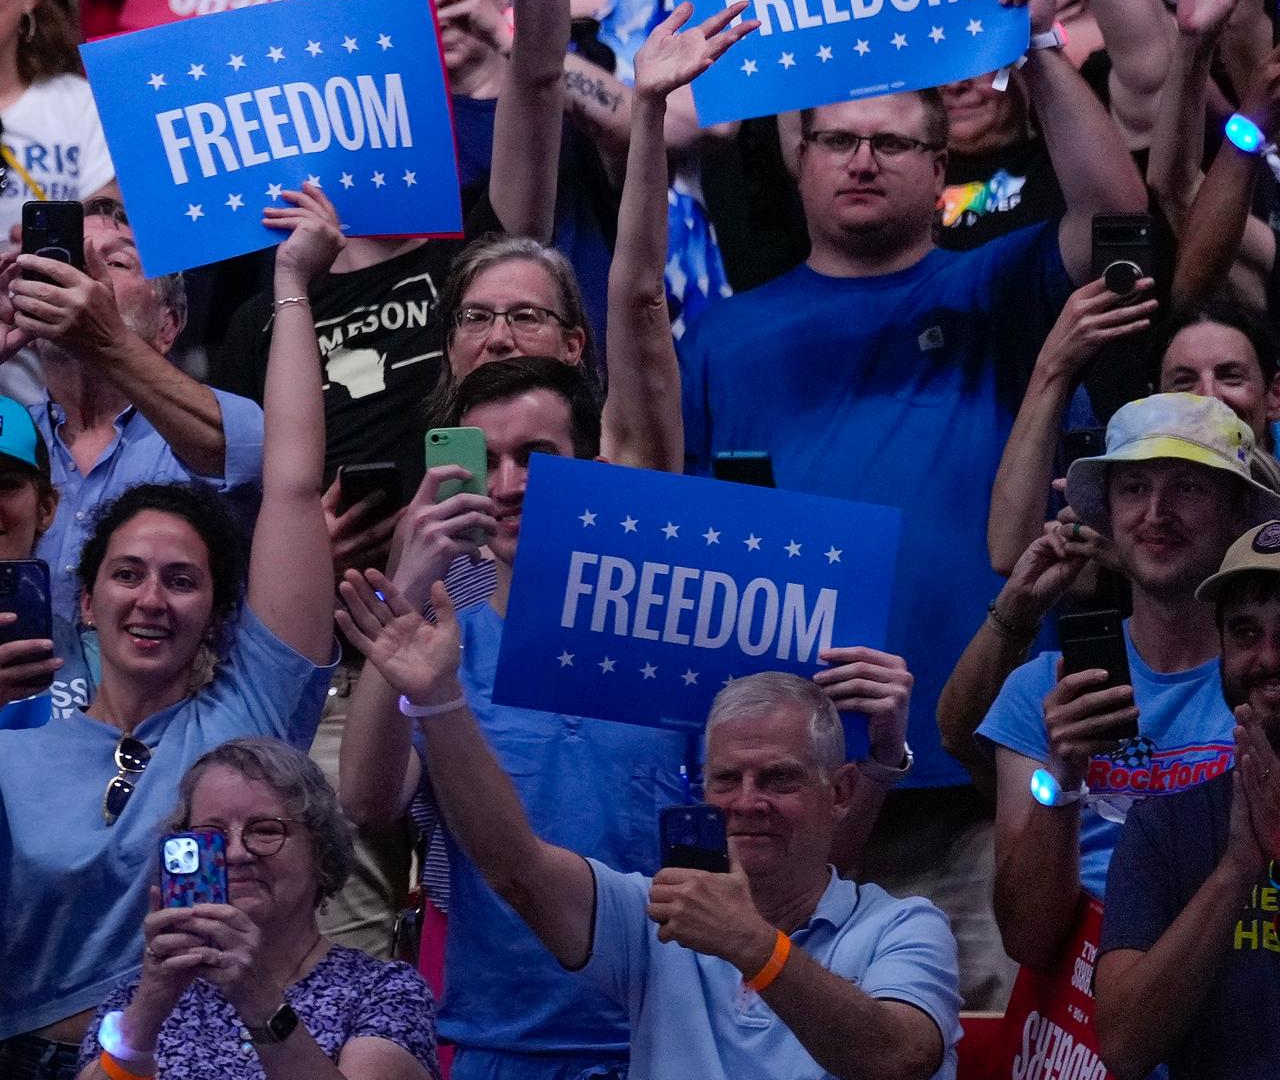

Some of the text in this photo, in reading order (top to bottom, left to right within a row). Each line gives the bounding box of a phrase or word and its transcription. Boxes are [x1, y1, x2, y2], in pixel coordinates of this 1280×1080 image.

[154, 73, 413, 186] FREEDOM
[560, 550, 840, 666] FREEDOM
[1087, 753, 1230, 792] Rockford
